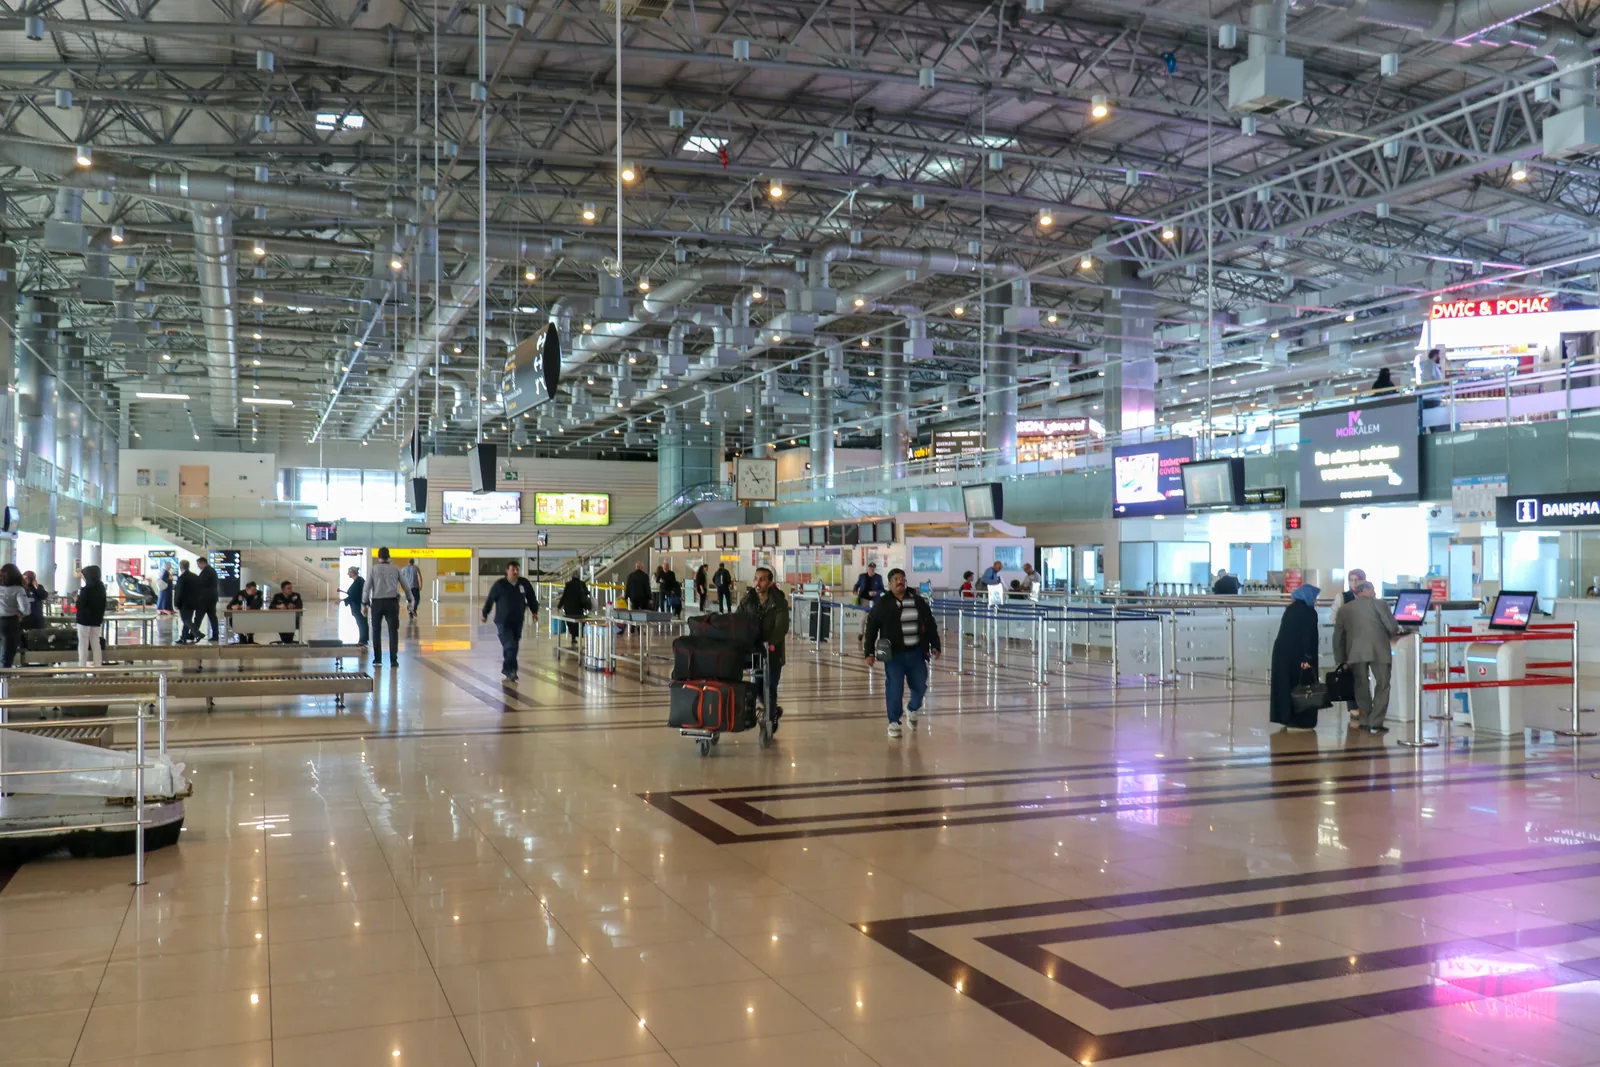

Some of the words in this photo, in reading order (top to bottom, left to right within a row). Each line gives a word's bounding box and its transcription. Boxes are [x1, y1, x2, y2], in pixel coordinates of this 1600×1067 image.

[1479, 301, 1492, 316] &
[1335, 423, 1380, 438] MORKALEM
[1542, 501, 1600, 518] DANIŞMA
